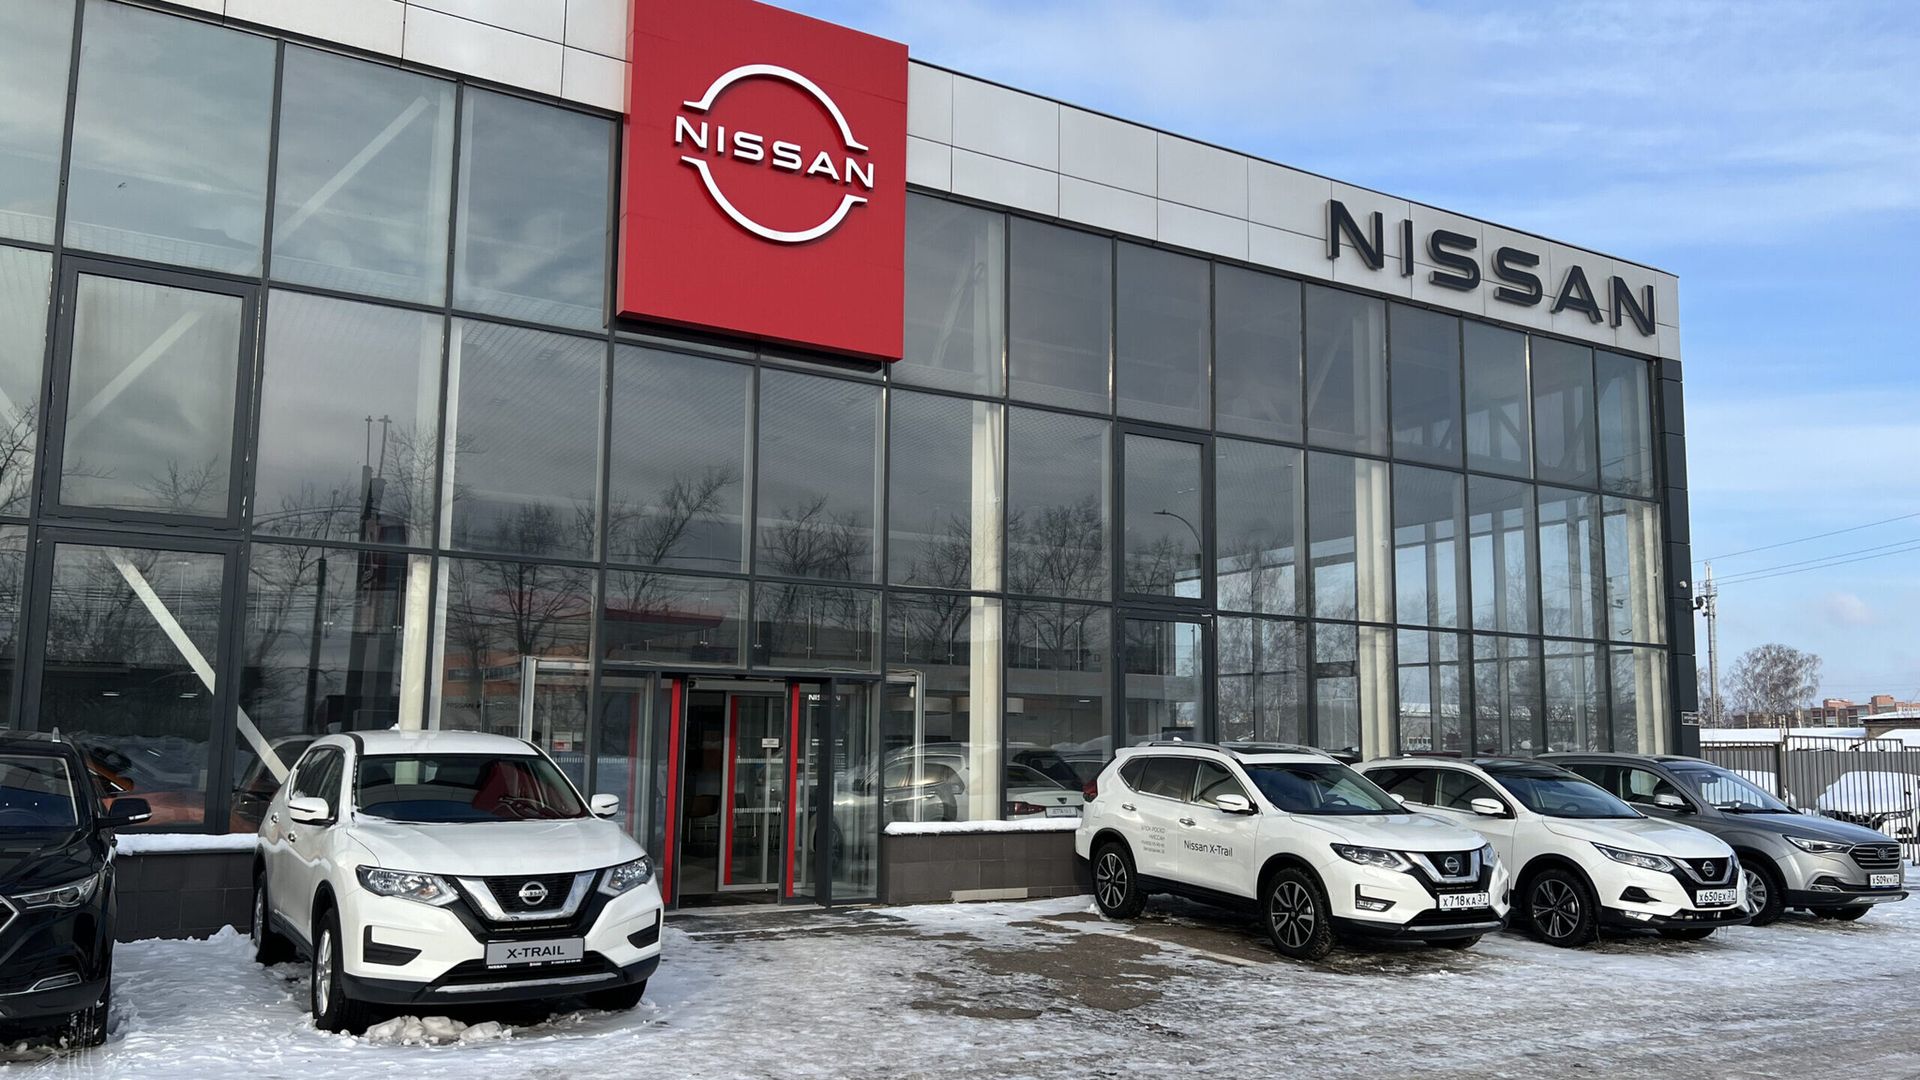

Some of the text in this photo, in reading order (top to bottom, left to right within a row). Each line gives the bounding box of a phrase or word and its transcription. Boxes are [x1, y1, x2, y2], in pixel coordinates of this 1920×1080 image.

[674, 115, 875, 189] NISSAN
[1325, 198, 1656, 337] NISSAN
[1183, 840, 1233, 857] Nissan X-Trail
[507, 946, 565, 959] X-TRAIL
